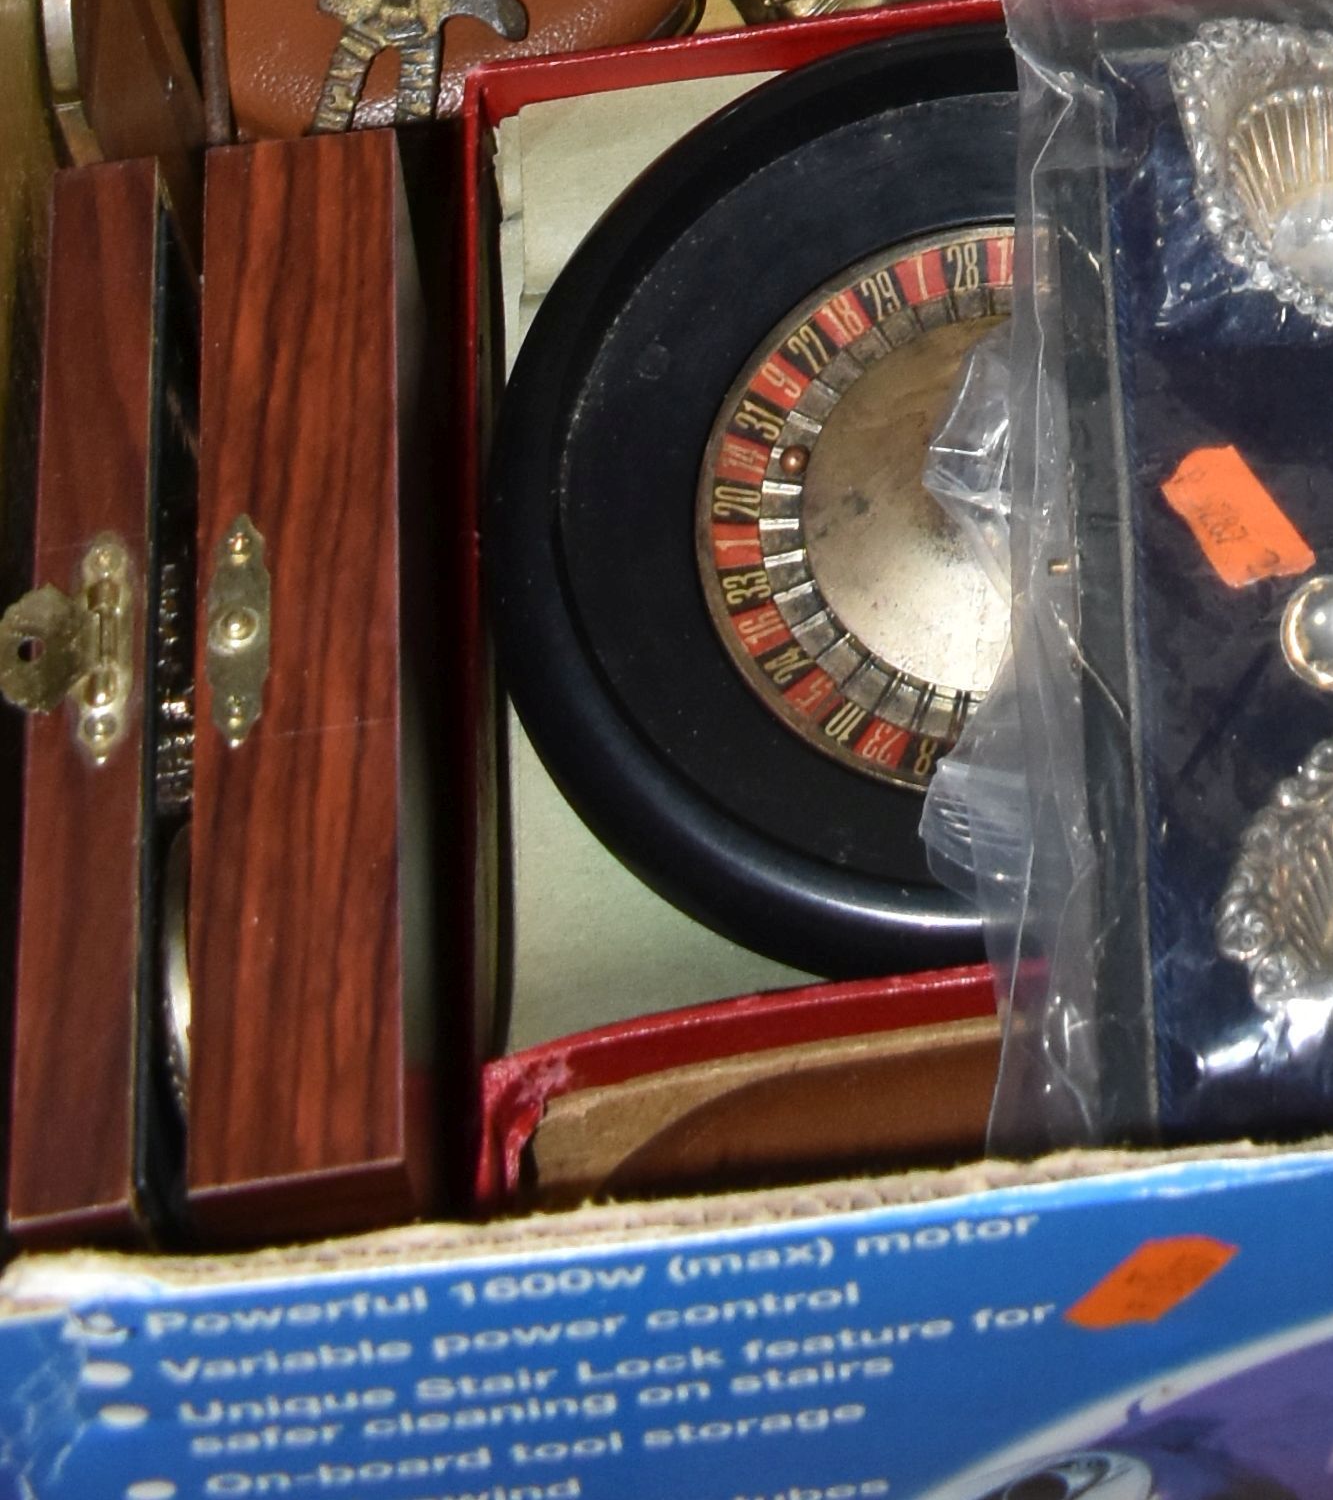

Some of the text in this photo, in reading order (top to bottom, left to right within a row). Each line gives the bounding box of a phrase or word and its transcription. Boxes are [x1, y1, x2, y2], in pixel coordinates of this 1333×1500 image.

[946, 242, 980, 292] 28
[820, 291, 864, 345] 18
[859, 270, 900, 322] 29
[761, 361, 802, 400] 9
[735, 399, 786, 441] 31
[712, 484, 763, 518] 20
[714, 538, 761, 551] 1
[722, 569, 772, 606] 33
[824, 702, 868, 745] 10
[912, 736, 938, 776] 8
[145, 1213, 1039, 1340] Powerful 1600w (max) motor
[159, 1280, 860, 1384] Variable power control
[179, 1302, 1057, 1428] Unique Stair Lock feature for
[191, 1352, 893, 1457] safer cleaning on stairs
[205, 1402, 865, 1495] On-board tool storage
